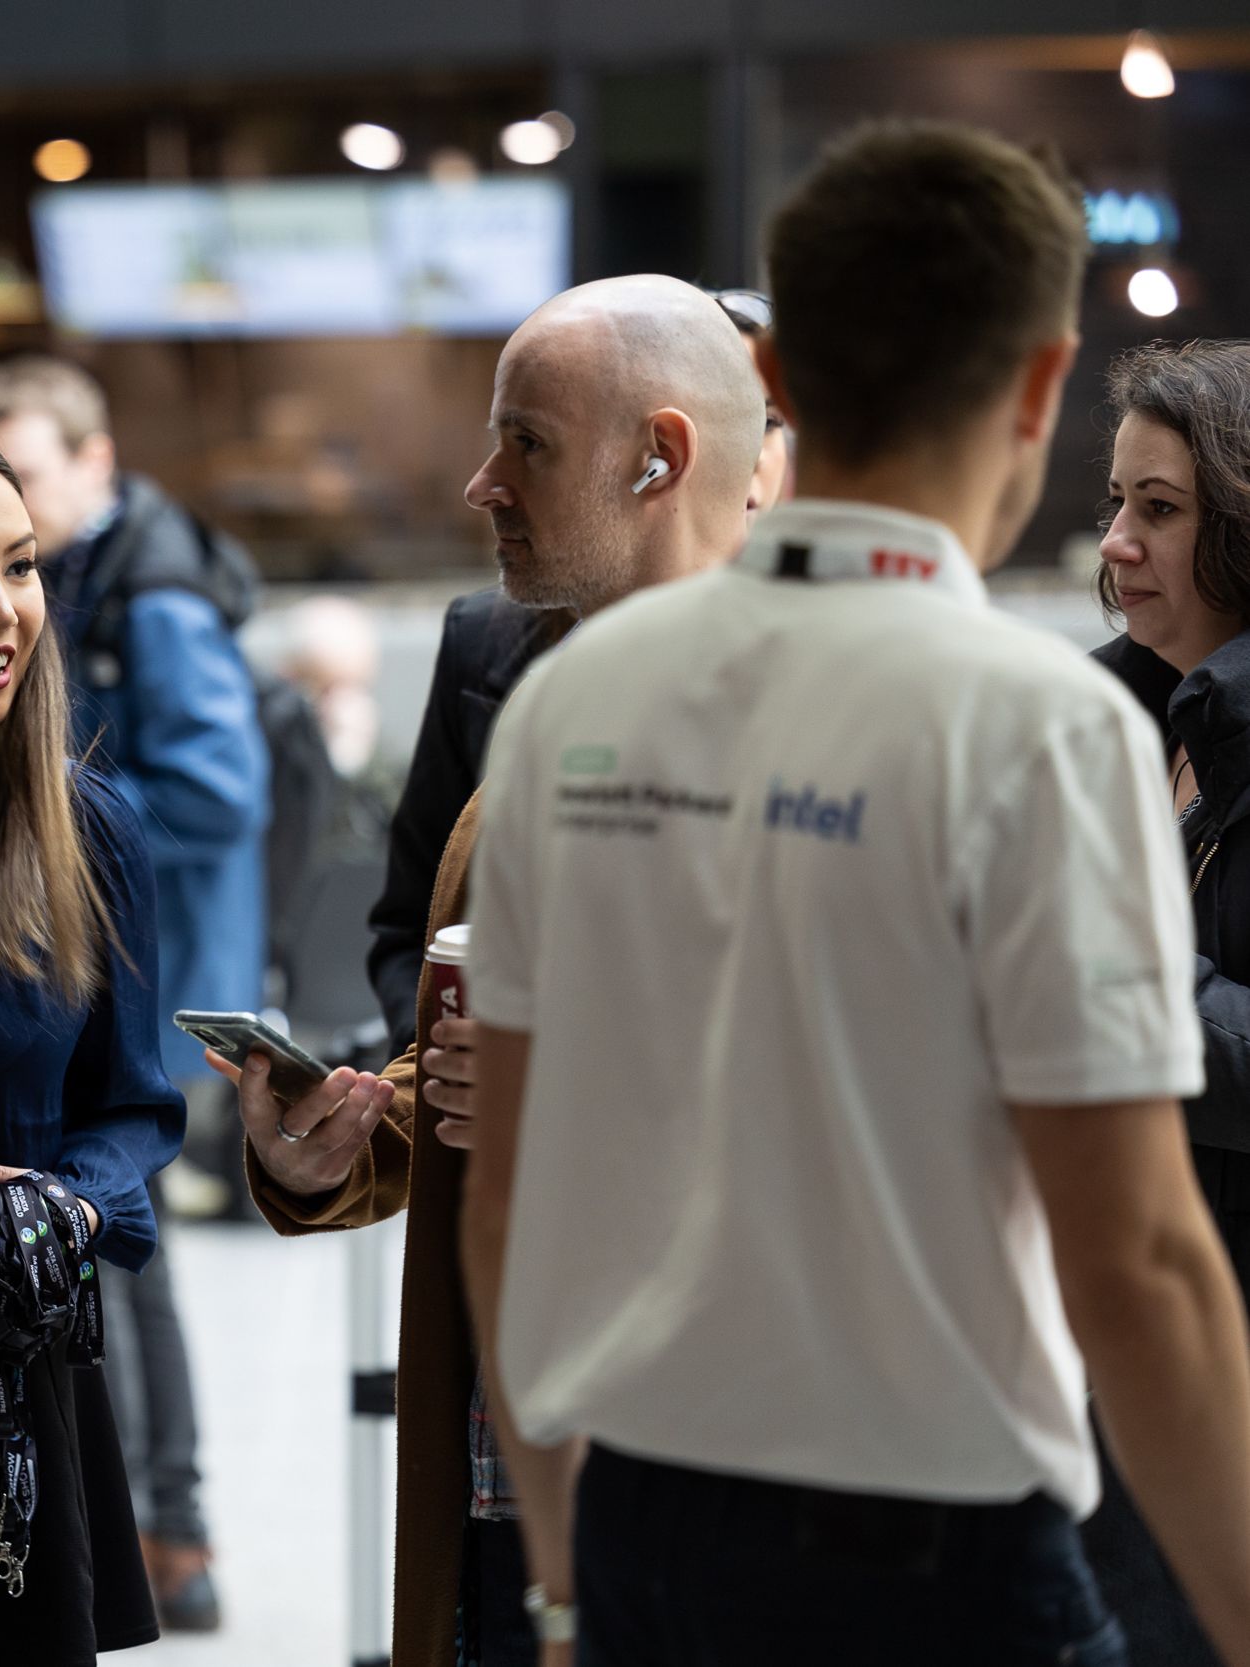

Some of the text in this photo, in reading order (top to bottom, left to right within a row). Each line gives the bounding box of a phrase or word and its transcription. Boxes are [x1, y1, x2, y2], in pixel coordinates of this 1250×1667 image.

[11, 1196, 24, 1217] WORLD
[15, 1185, 29, 1213] BIG DATA
[46, 1246, 58, 1264] DATA
